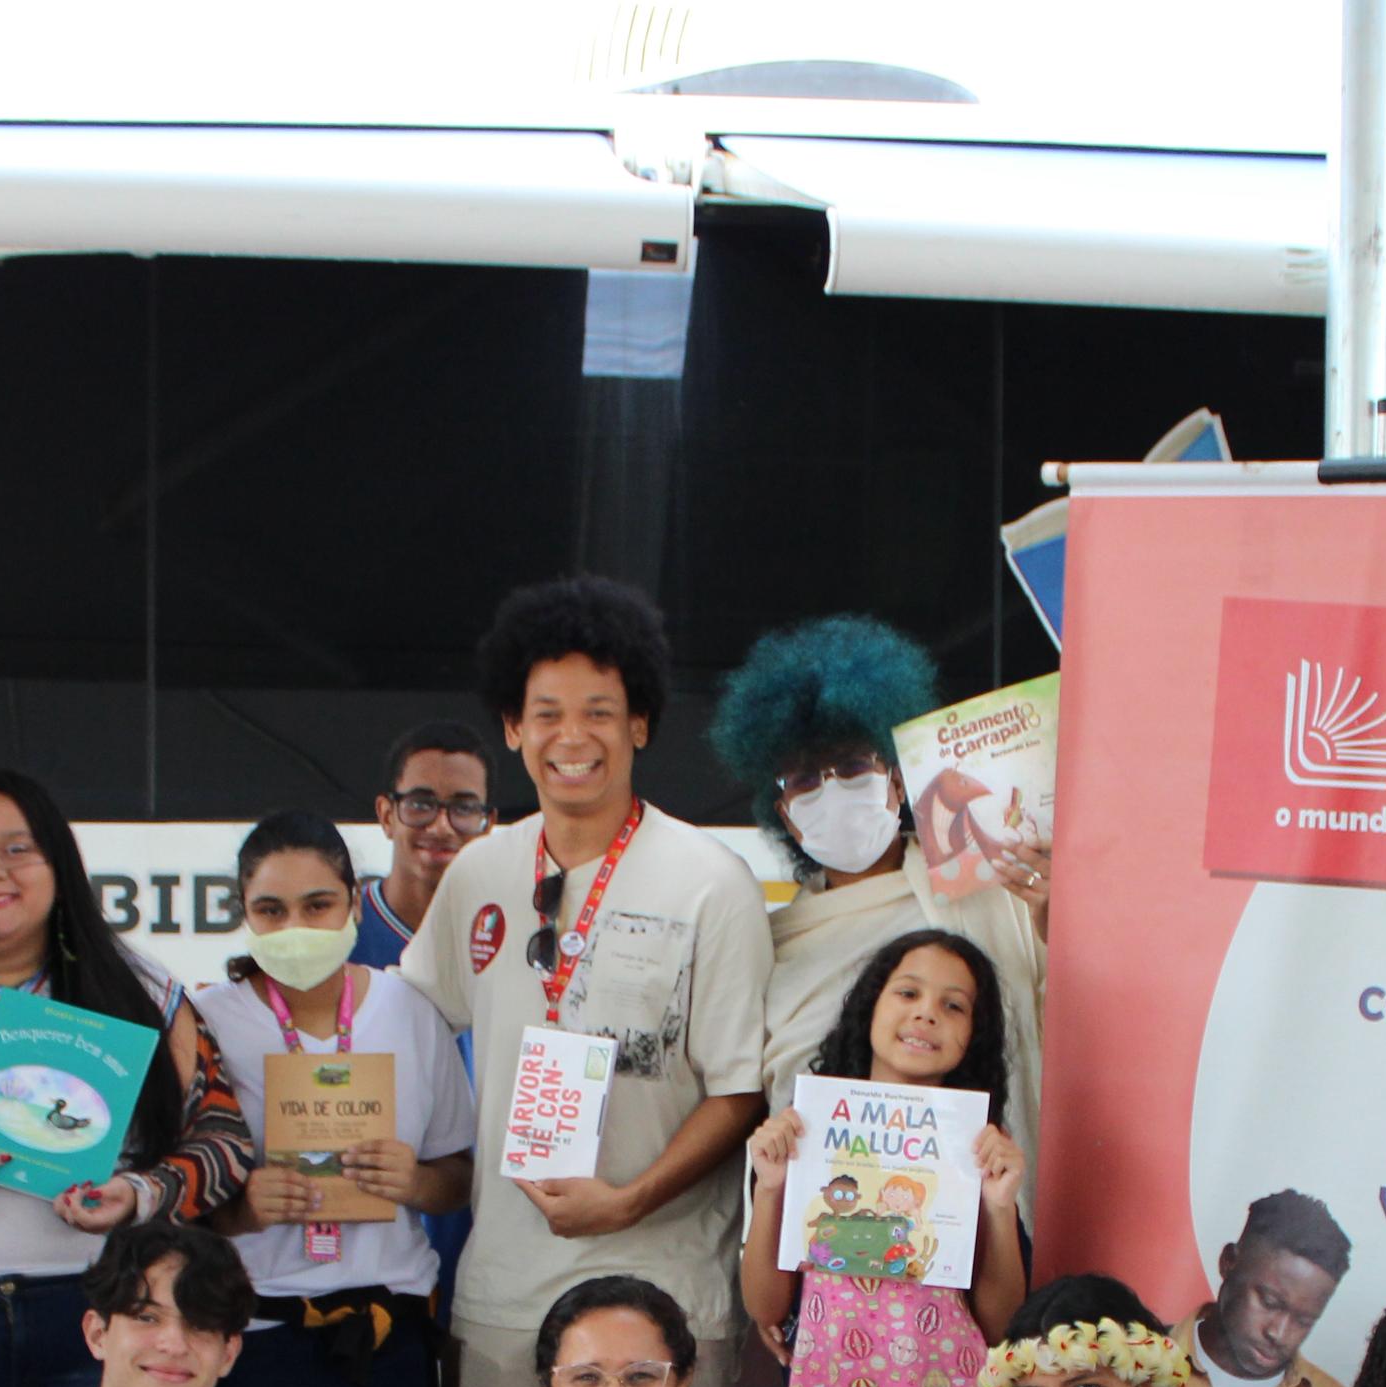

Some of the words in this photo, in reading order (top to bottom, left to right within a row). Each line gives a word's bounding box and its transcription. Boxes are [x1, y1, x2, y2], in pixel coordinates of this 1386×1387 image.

[1275, 809, 1291, 829] o
[508, 1042, 545, 1139] ÁRVORE
[280, 1101, 308, 1116] VIDA
[315, 1101, 329, 1116] DE
[336, 1101, 382, 1116] COLONO
[557, 1089, 581, 1134] TOS
[831, 1098, 851, 1122] A
[861, 1101, 937, 1132] MALA
[530, 1128, 553, 1159] DE
[824, 1127, 940, 1161] MALUCA
